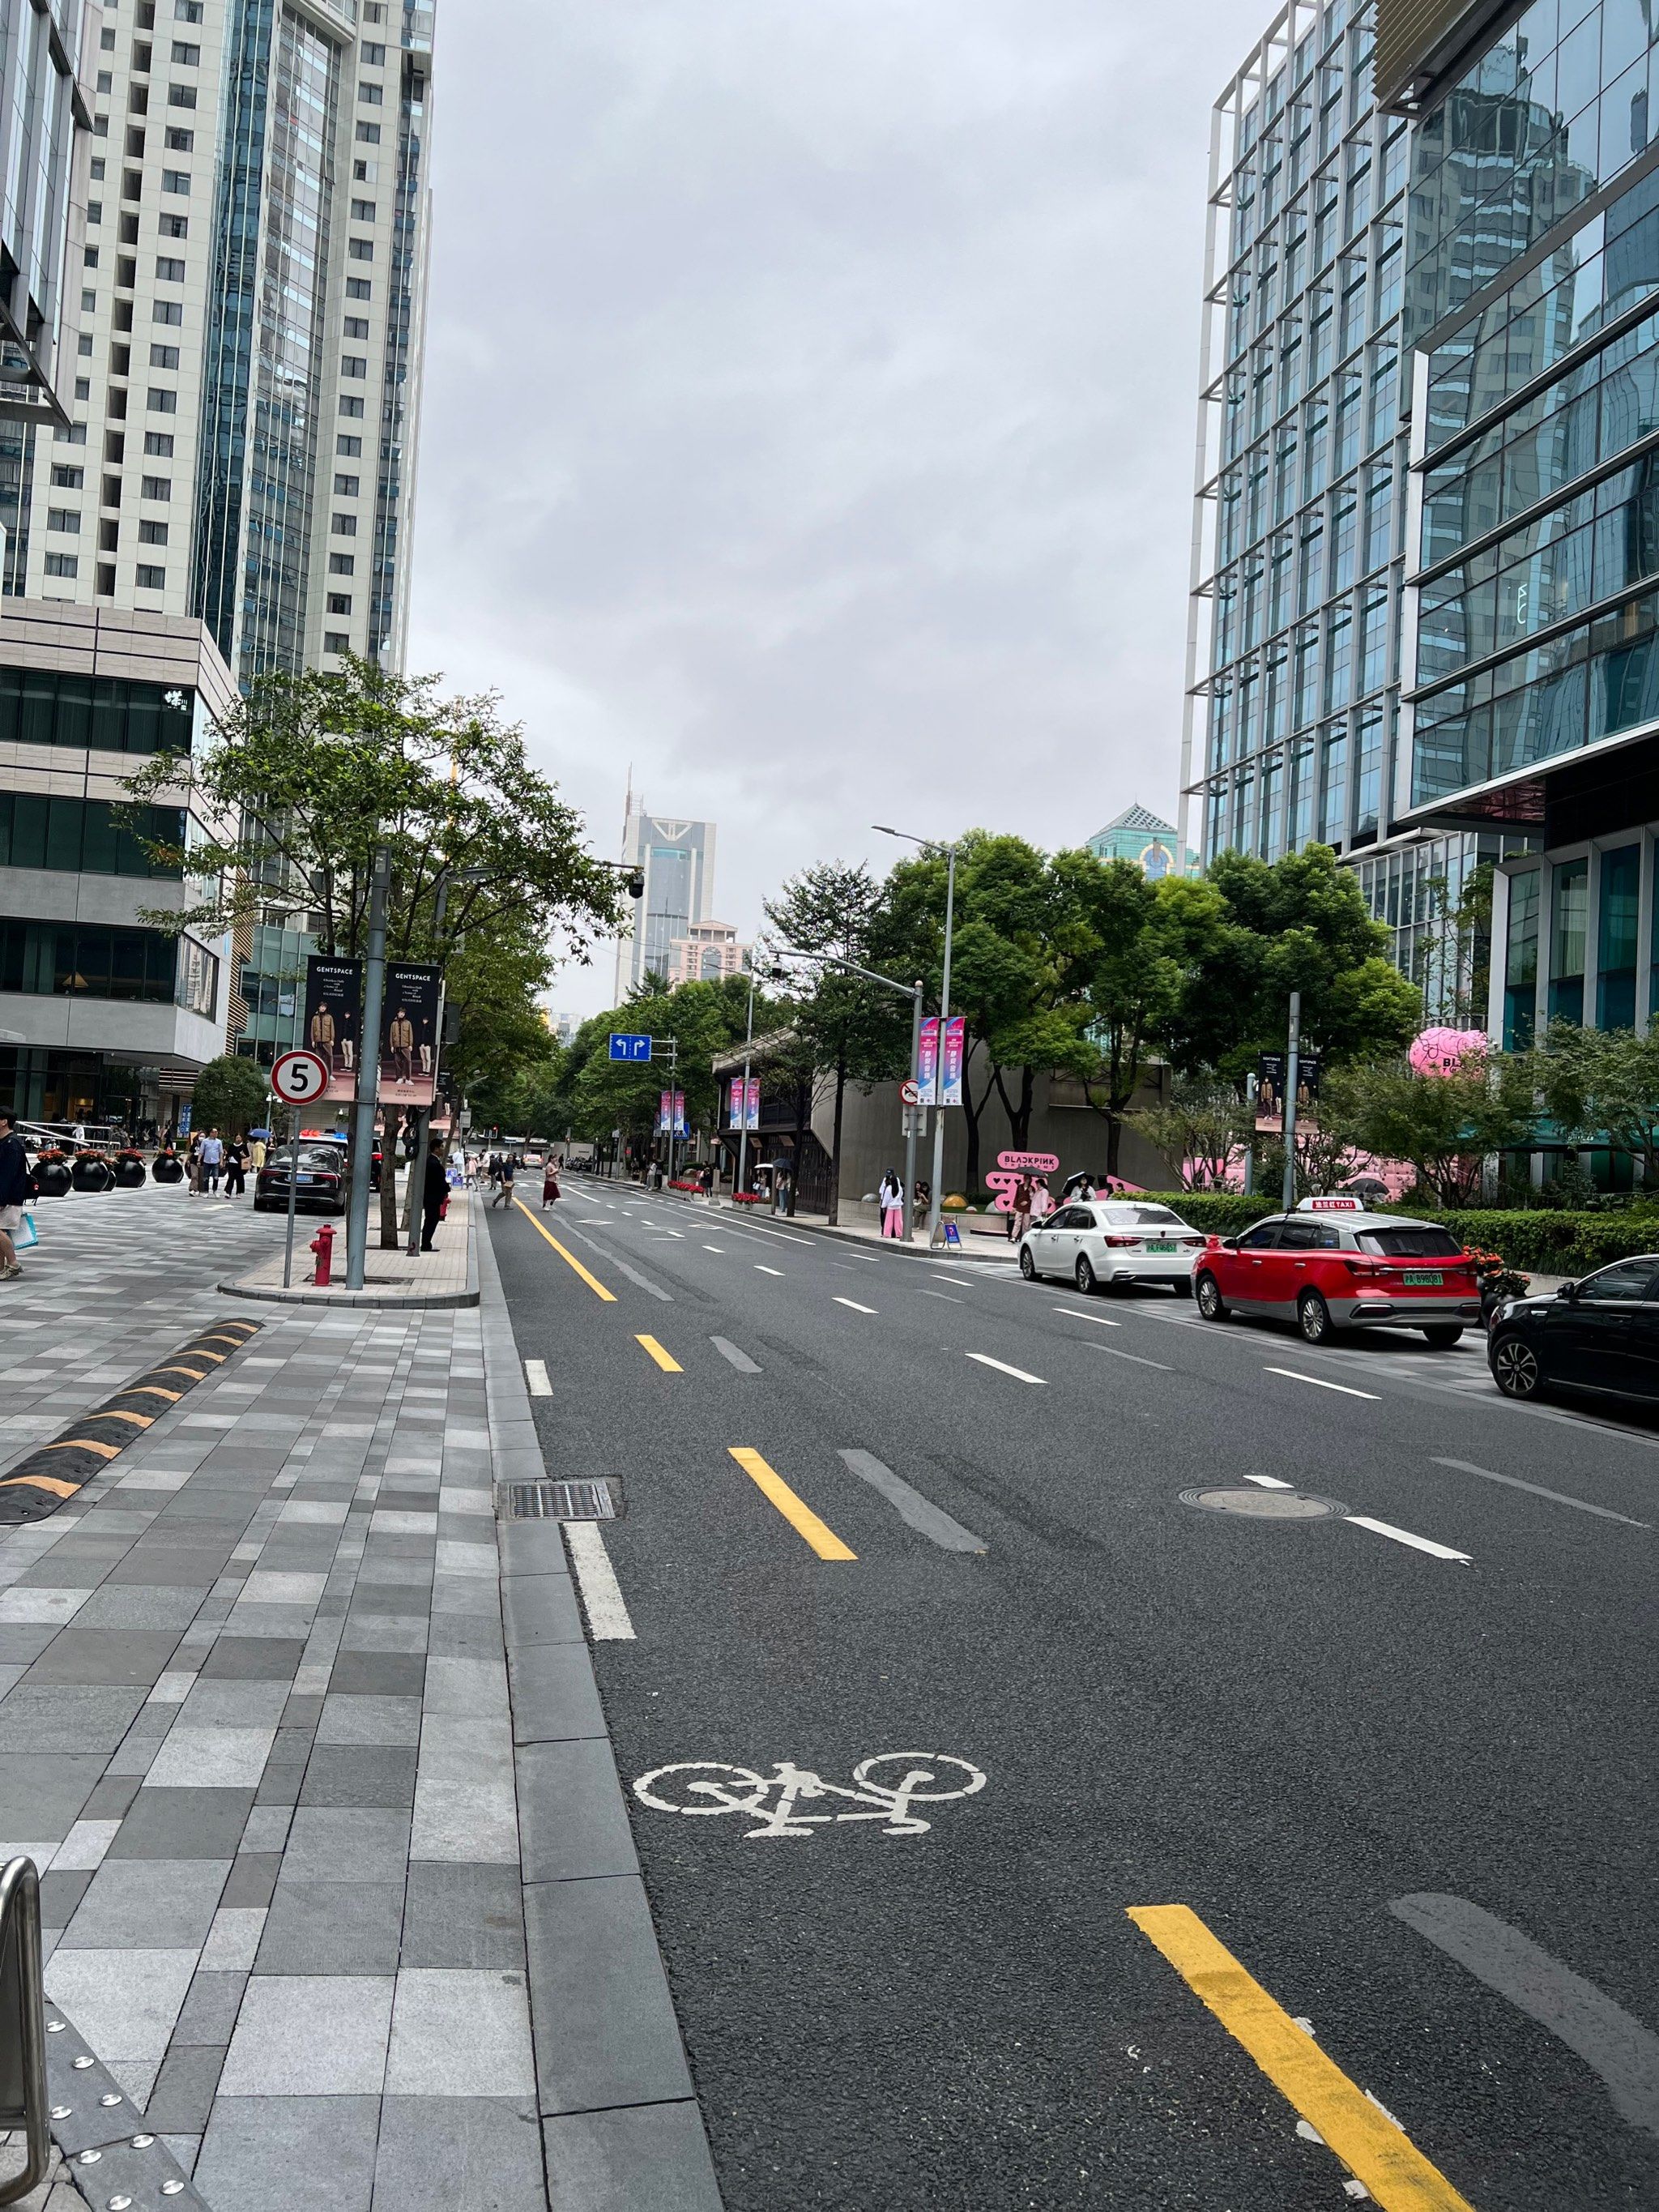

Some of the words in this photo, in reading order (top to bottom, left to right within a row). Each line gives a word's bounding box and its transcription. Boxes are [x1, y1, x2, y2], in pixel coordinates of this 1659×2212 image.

[316, 966, 353, 975] GENTSPACE
[395, 972, 431, 982] GENTSPACE
[289, 1063, 309, 1092] 5
